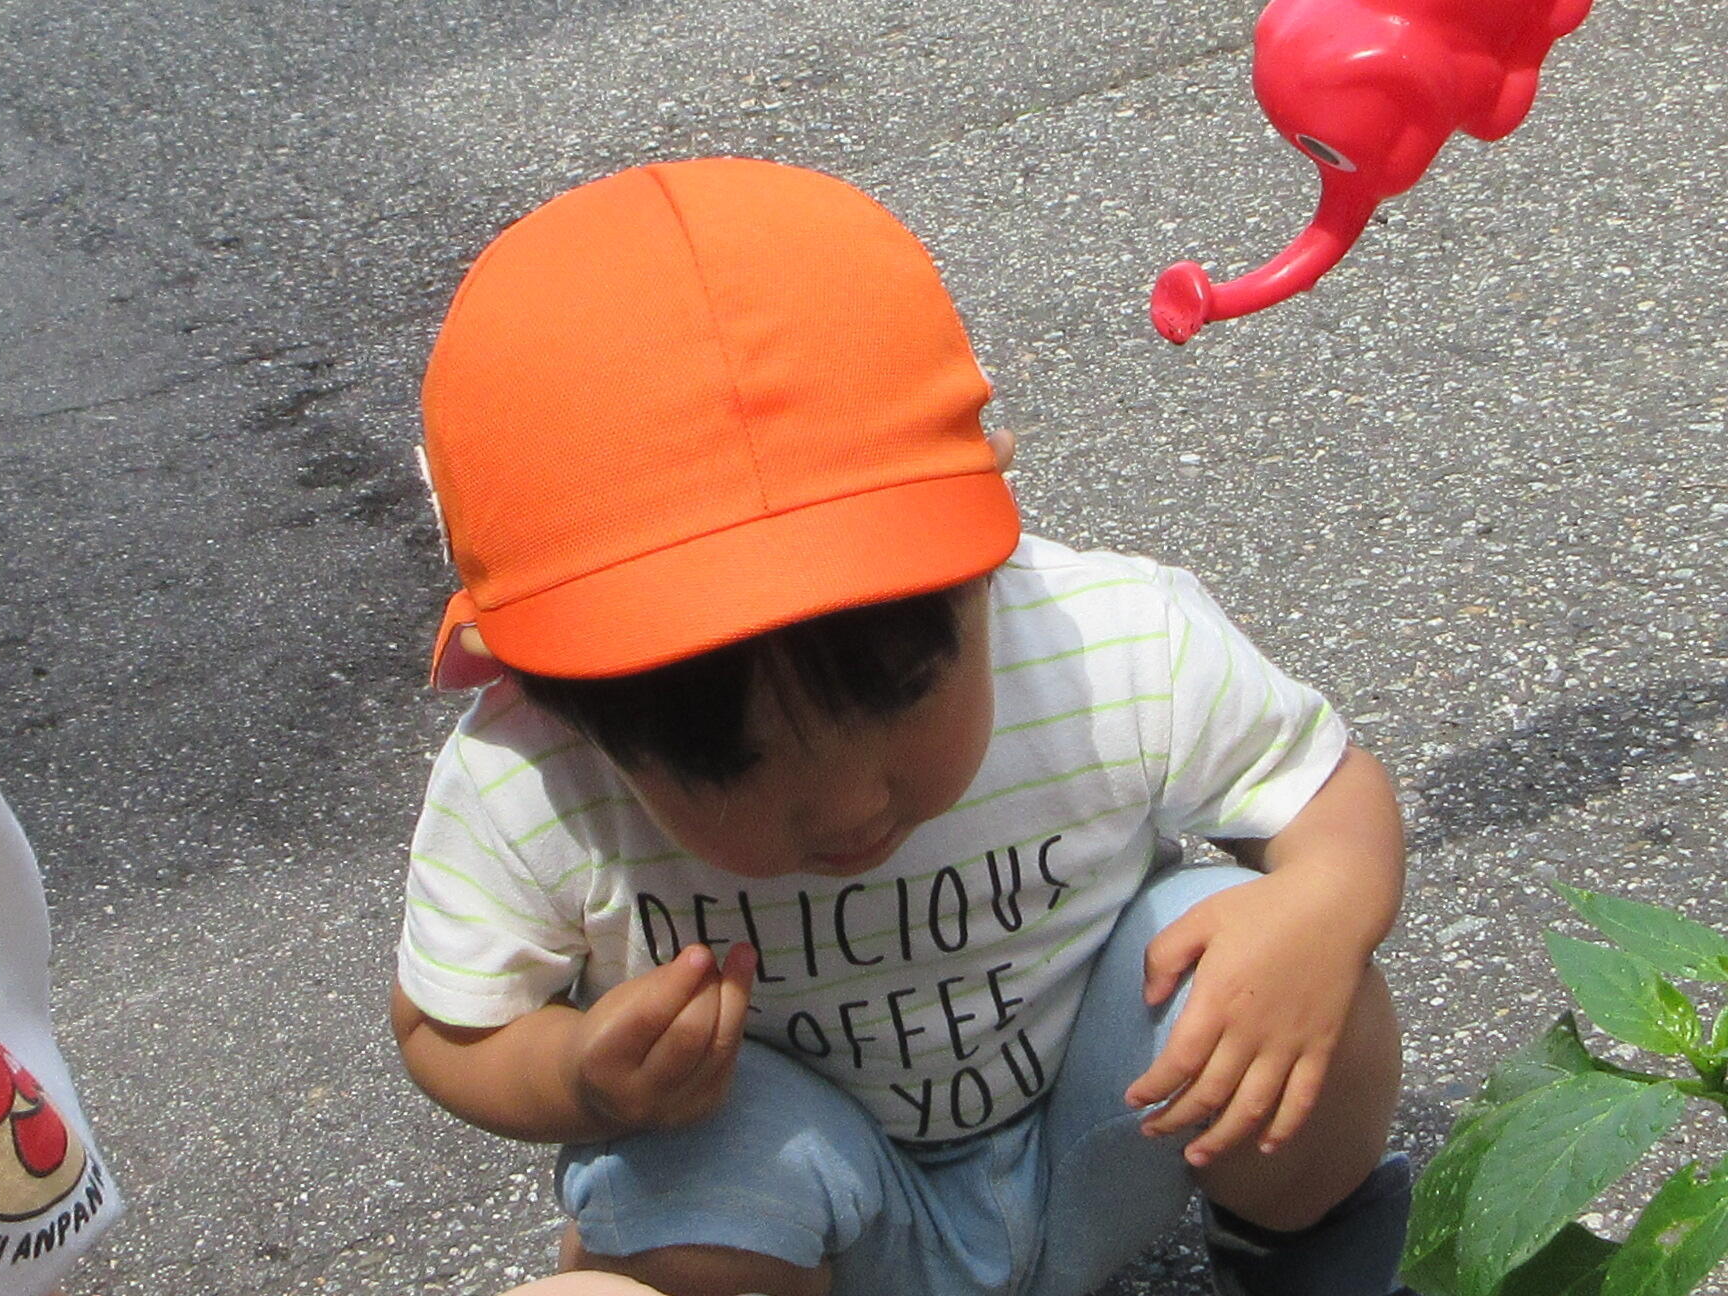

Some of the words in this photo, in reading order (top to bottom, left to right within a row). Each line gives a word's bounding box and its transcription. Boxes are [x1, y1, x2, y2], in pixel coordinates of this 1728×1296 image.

[637, 835, 1069, 983] DELICIOUS
[748, 961, 1024, 1069] OFFEE
[890, 1029, 1045, 1137] YOU
